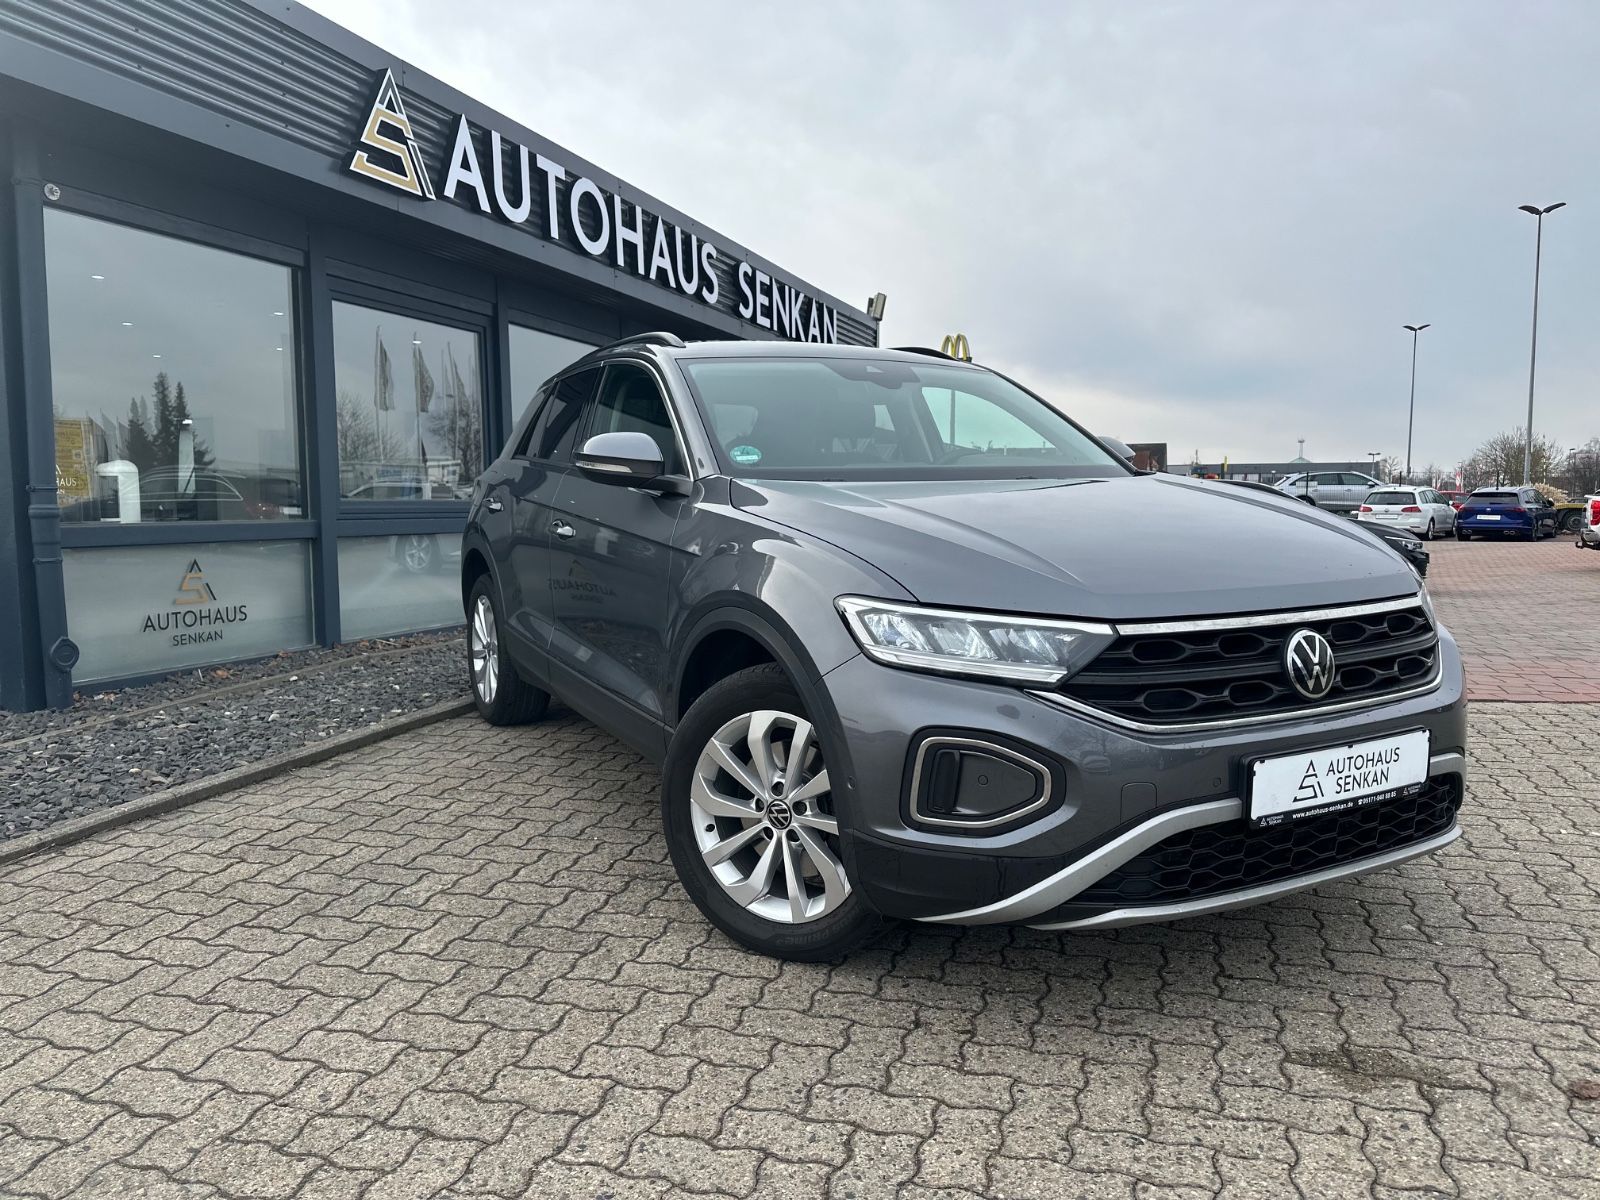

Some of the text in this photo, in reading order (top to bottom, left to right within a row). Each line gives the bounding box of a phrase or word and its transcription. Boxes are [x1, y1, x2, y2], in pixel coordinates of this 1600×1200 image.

[444, 113, 838, 344] AUTOHAUS SENKAN
[143, 604, 248, 633] AUTOHAUS
[172, 629, 223, 647] SENKAN
[1326, 746, 1401, 777] AUTOHAUS
[1335, 767, 1390, 795] SENKAN
[1292, 801, 1354, 820] www.autohaus-senkan.de
